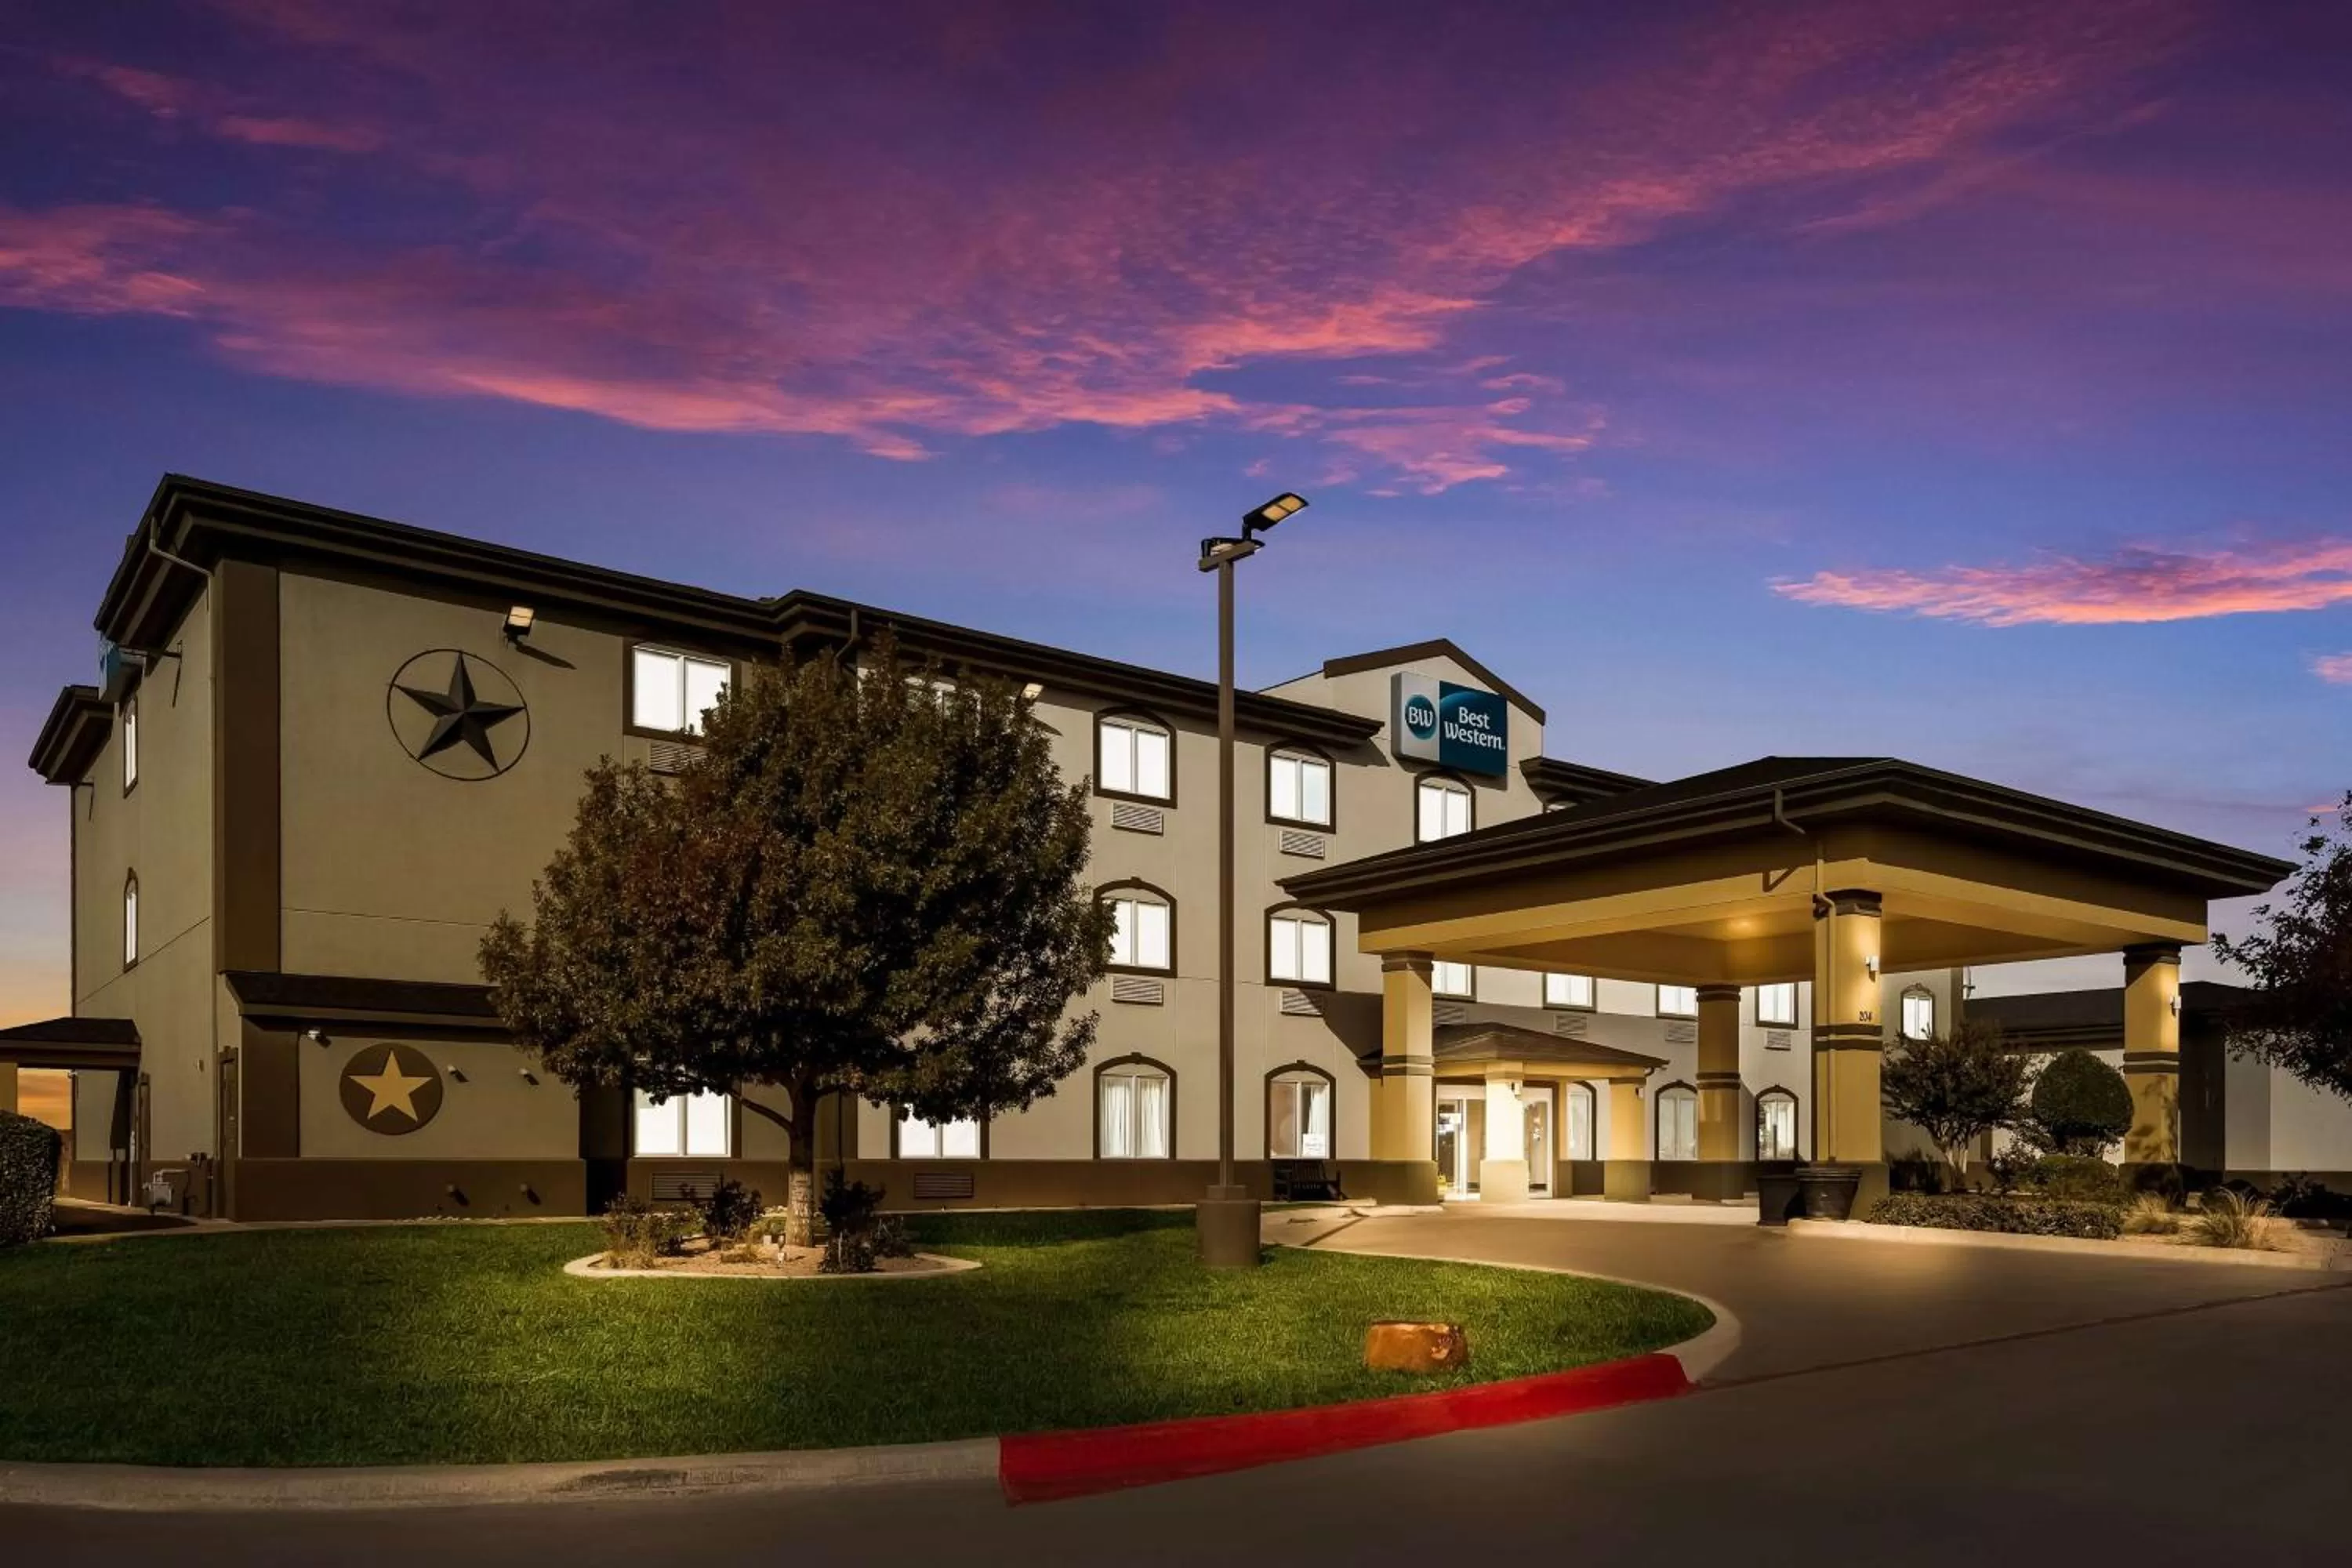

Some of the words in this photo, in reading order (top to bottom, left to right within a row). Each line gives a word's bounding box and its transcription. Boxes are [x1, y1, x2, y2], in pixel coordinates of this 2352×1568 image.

[1408, 707, 1434, 728] BW
[1459, 706, 1490, 729] Best
[1444, 720, 1502, 750] Western
